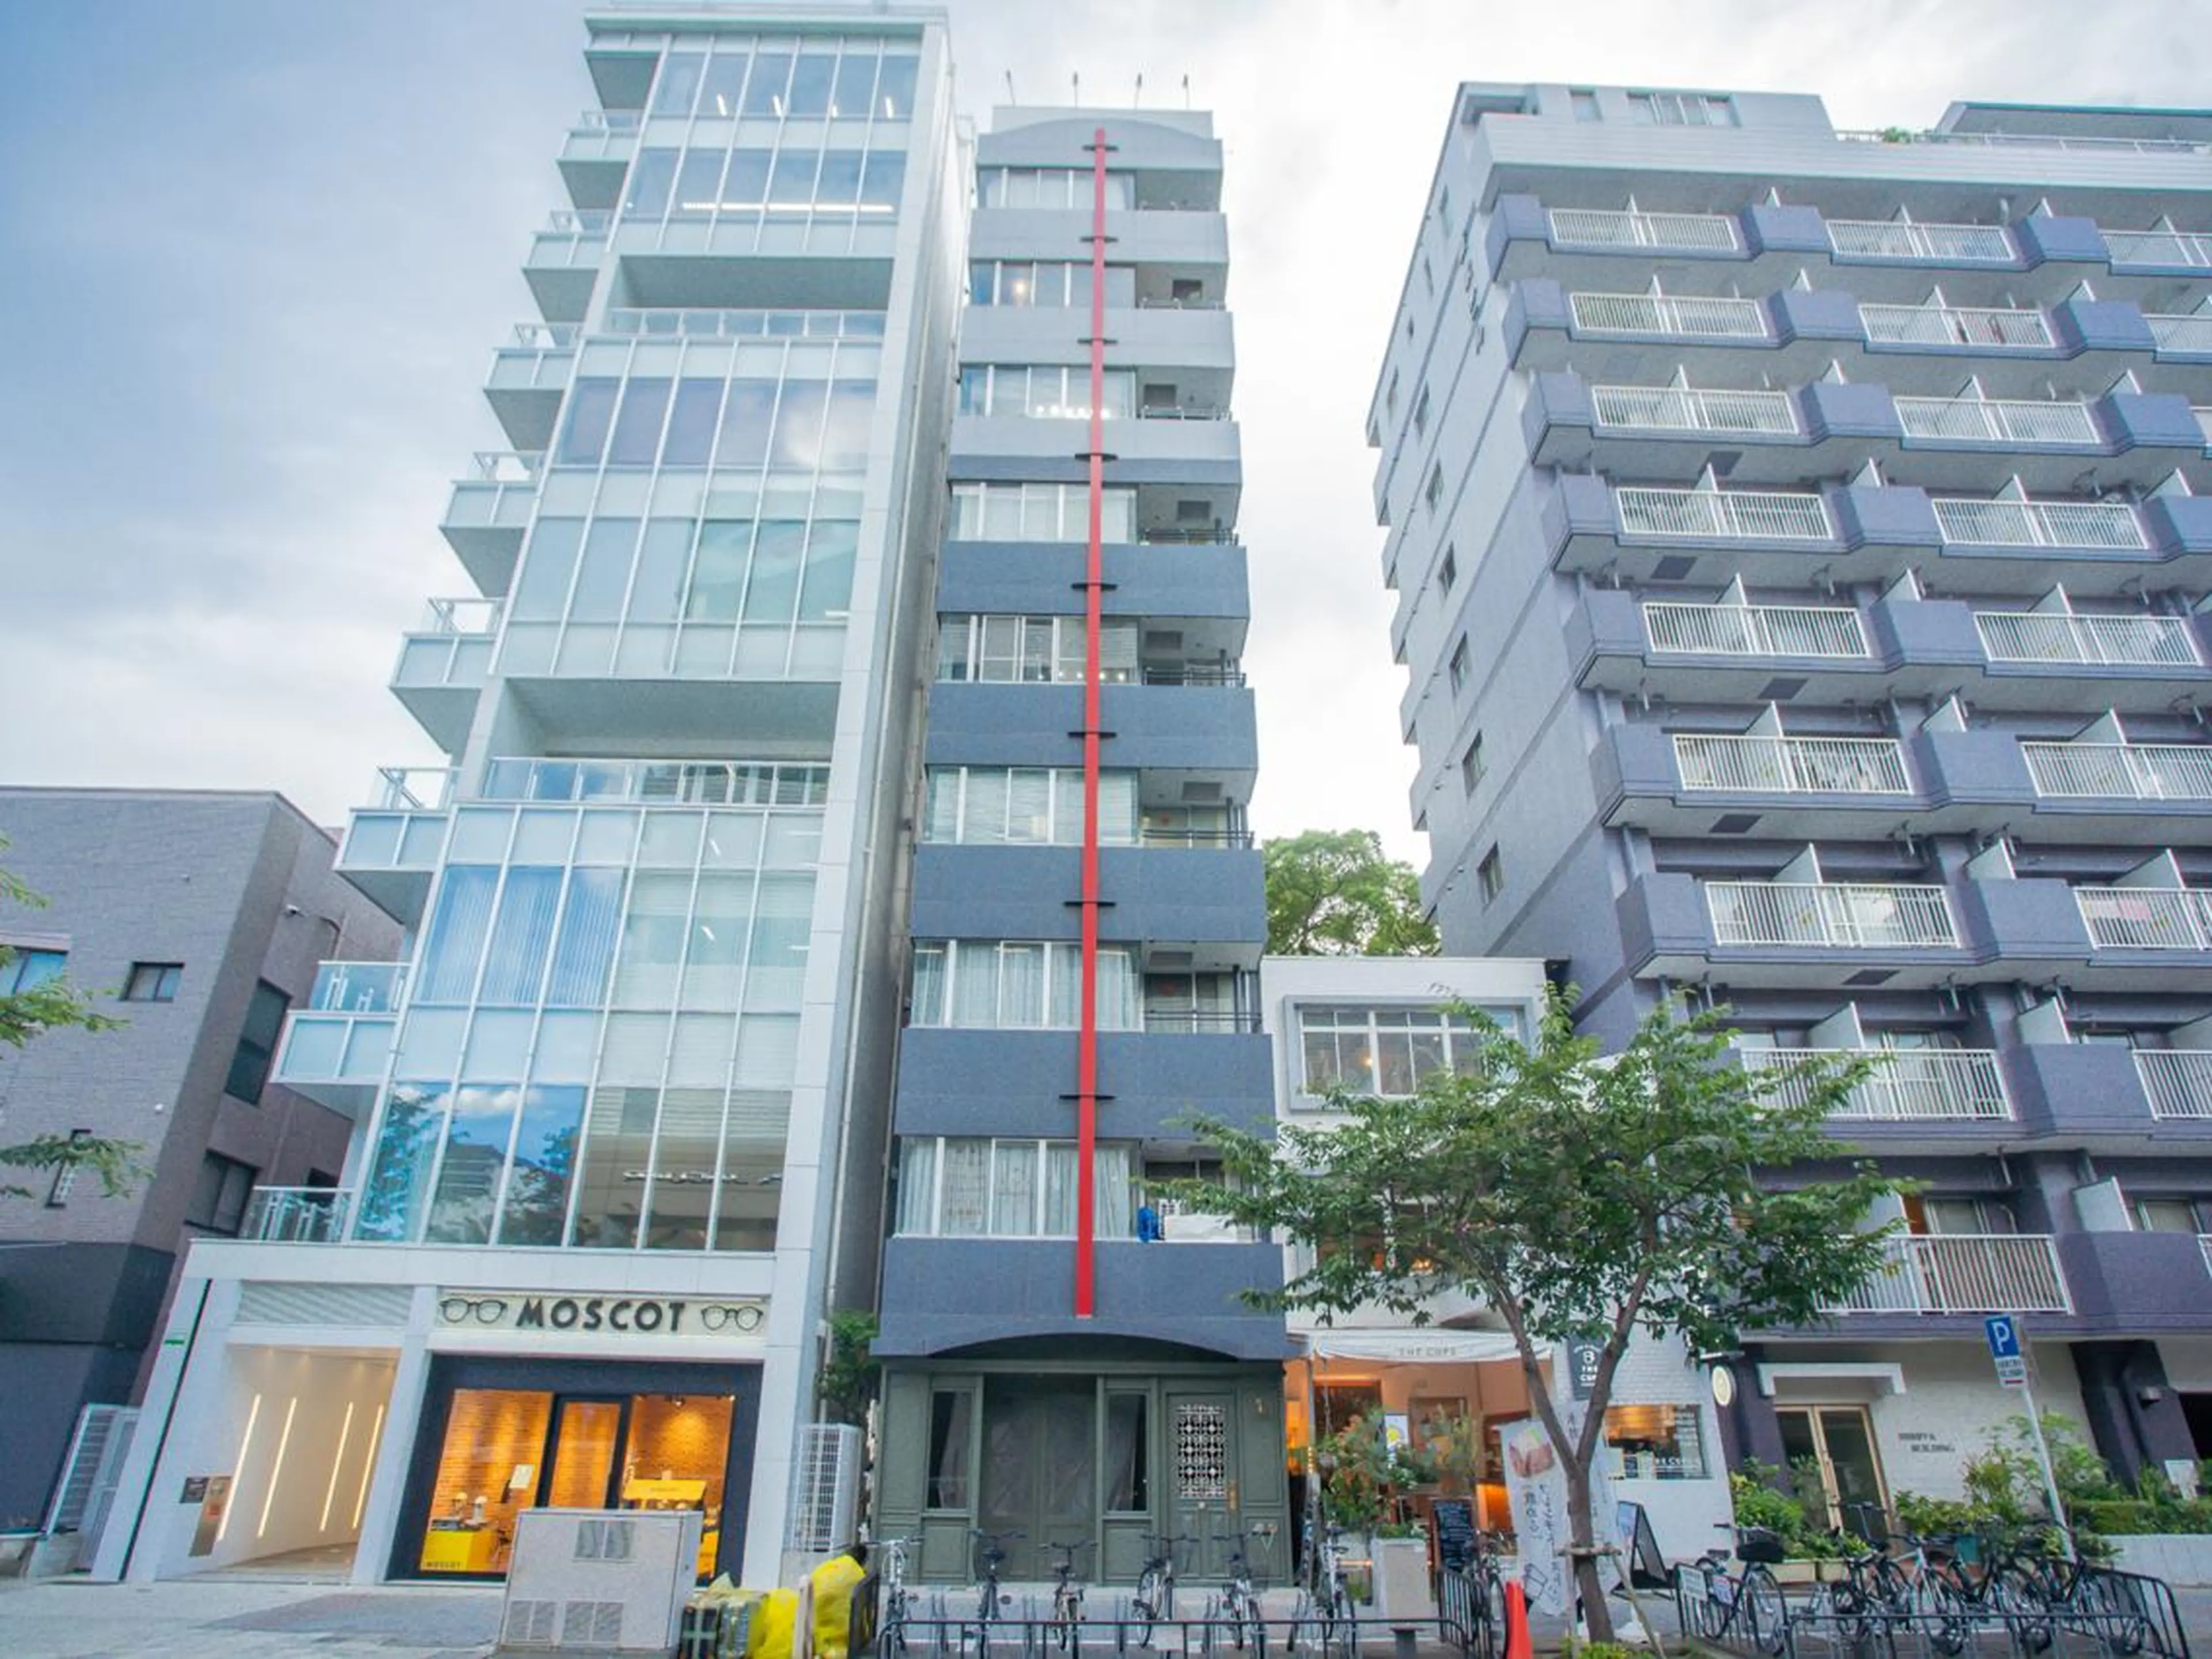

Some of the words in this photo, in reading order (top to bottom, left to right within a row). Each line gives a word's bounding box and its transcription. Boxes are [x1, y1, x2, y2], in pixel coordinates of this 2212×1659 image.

[516, 1297, 685, 1332] MOSCOT
[1397, 1347, 1423, 1357] THE
[1991, 1321, 2010, 1354] P
